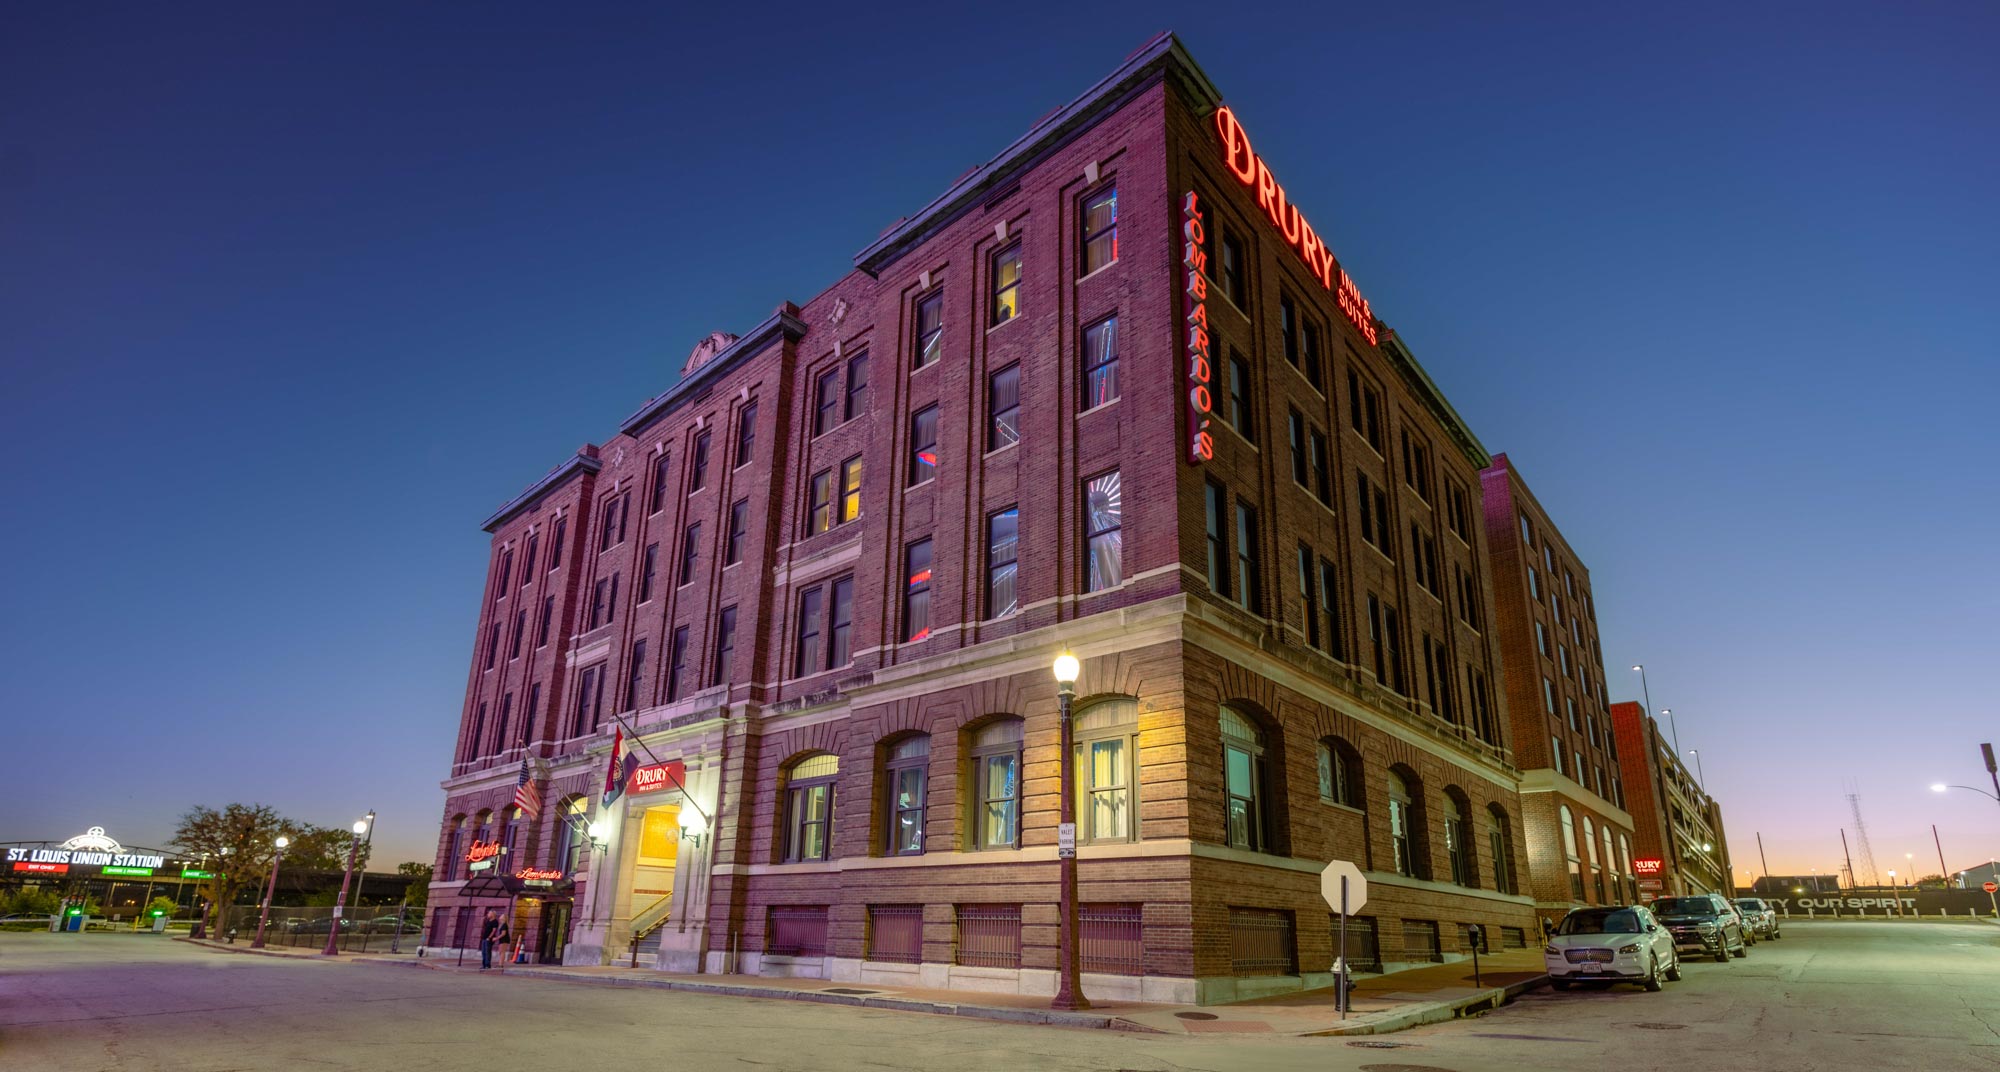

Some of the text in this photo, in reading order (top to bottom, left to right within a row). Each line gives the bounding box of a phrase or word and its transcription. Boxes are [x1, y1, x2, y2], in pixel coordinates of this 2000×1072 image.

[1216, 105, 1334, 290] DRURY
[1338, 287, 1377, 346] SUITES
[1340, 268, 1371, 320] INN &
[1184, 190, 1213, 461] LOMBARDO'S
[7, 848, 164, 868] ST. LOUIS UNION STATION
[1635, 860, 1660, 868] RURY
[1797, 898, 1844, 908] OUR
